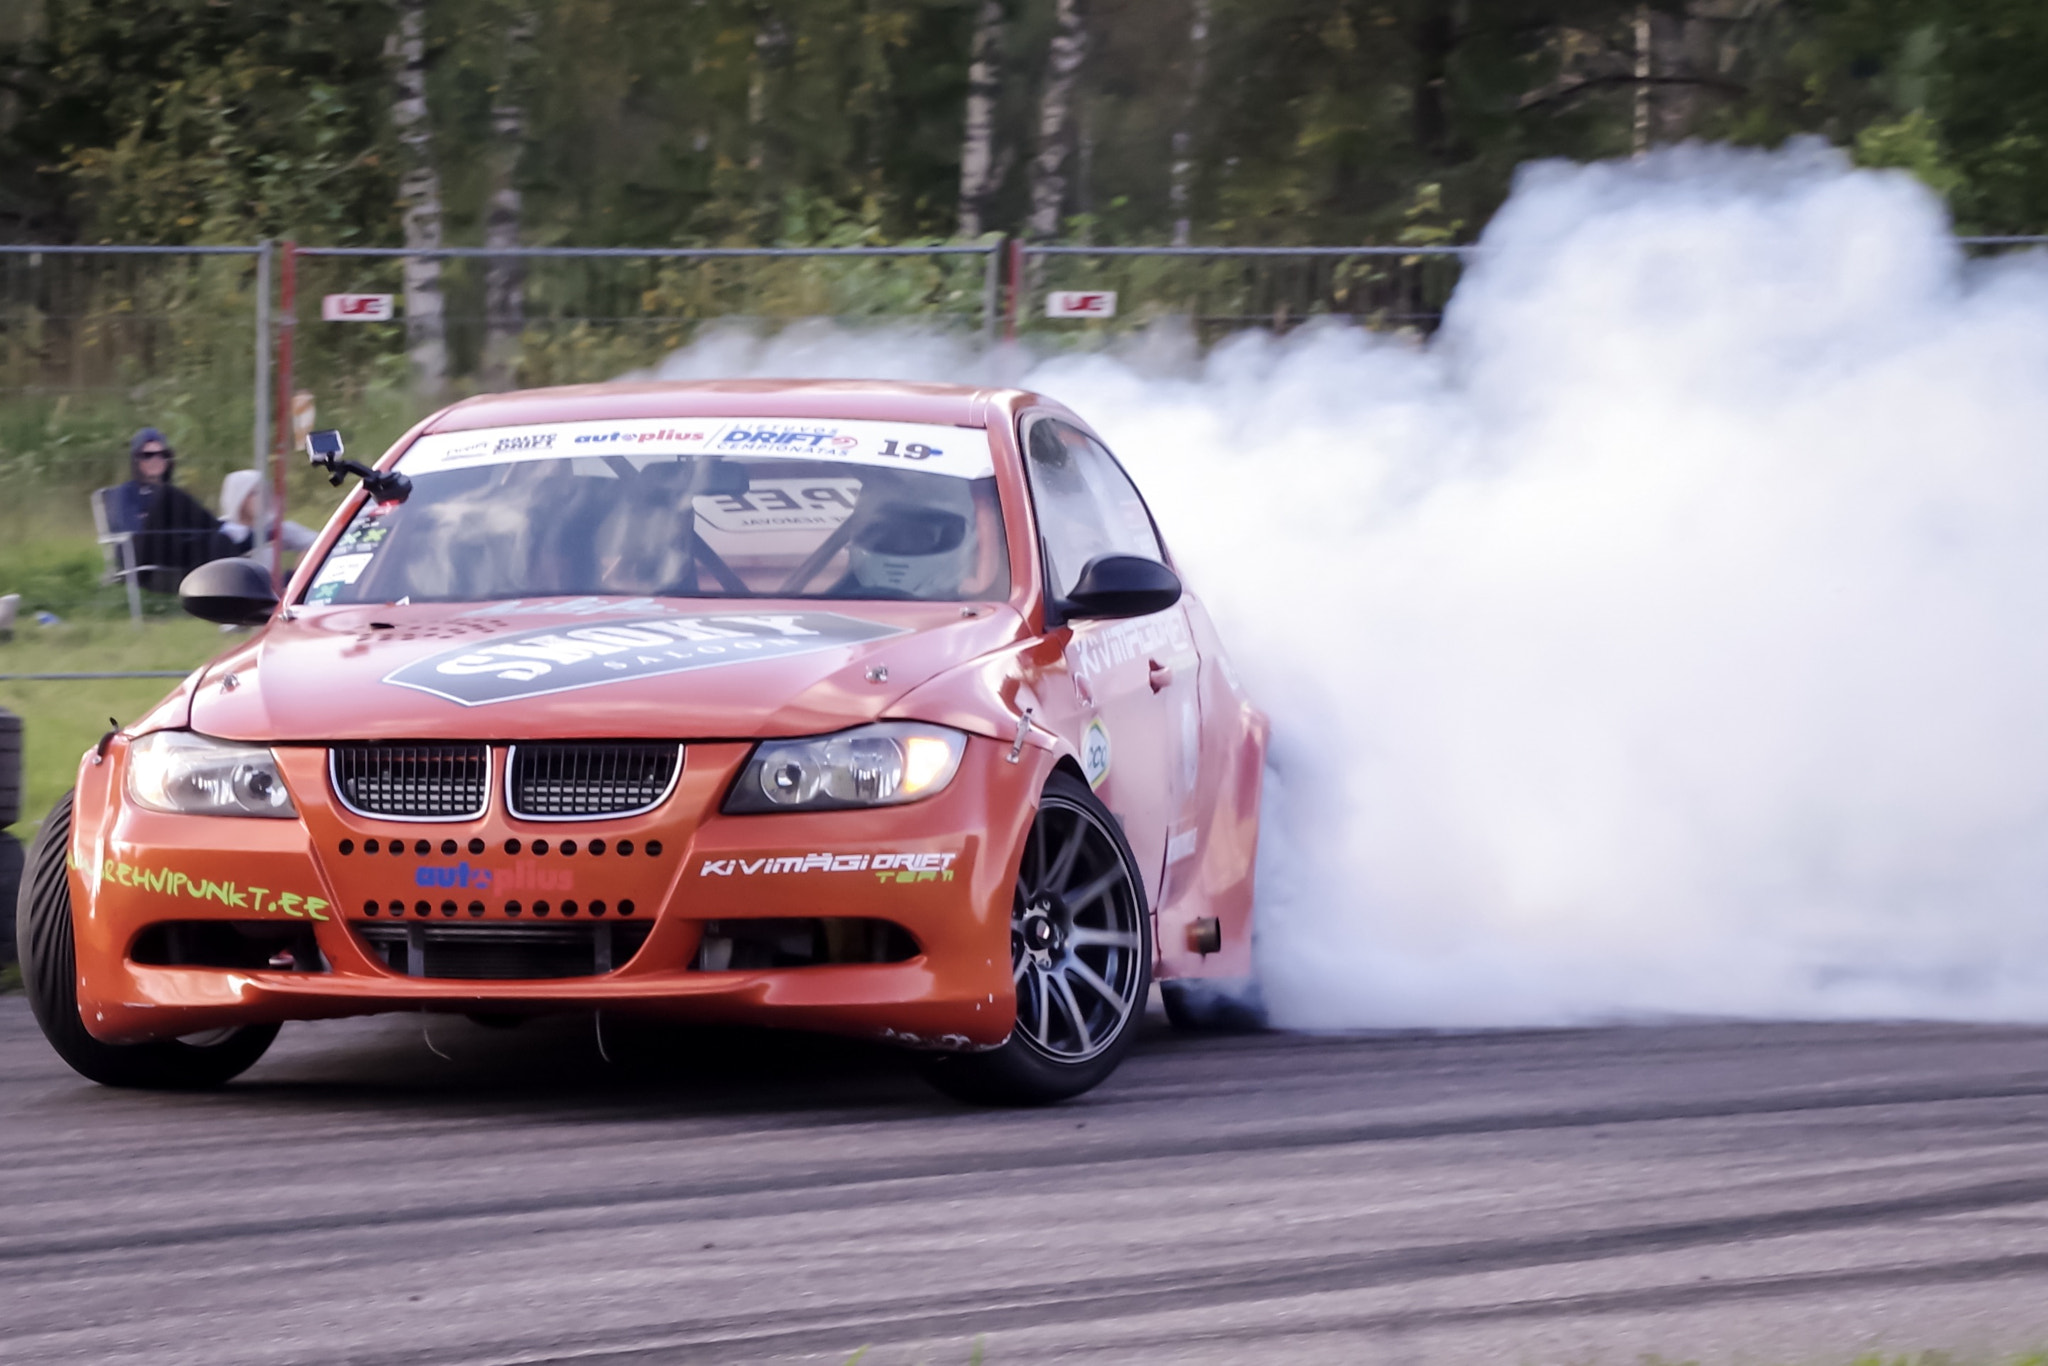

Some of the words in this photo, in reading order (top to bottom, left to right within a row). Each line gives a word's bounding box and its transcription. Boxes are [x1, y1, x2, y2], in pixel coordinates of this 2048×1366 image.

[723, 430, 834, 446] DRIFT
[878, 438, 933, 460] 19
[436, 615, 820, 682] SMOKY
[603, 638, 799, 670] SALOON
[871, 852, 956, 873] DRIFT
